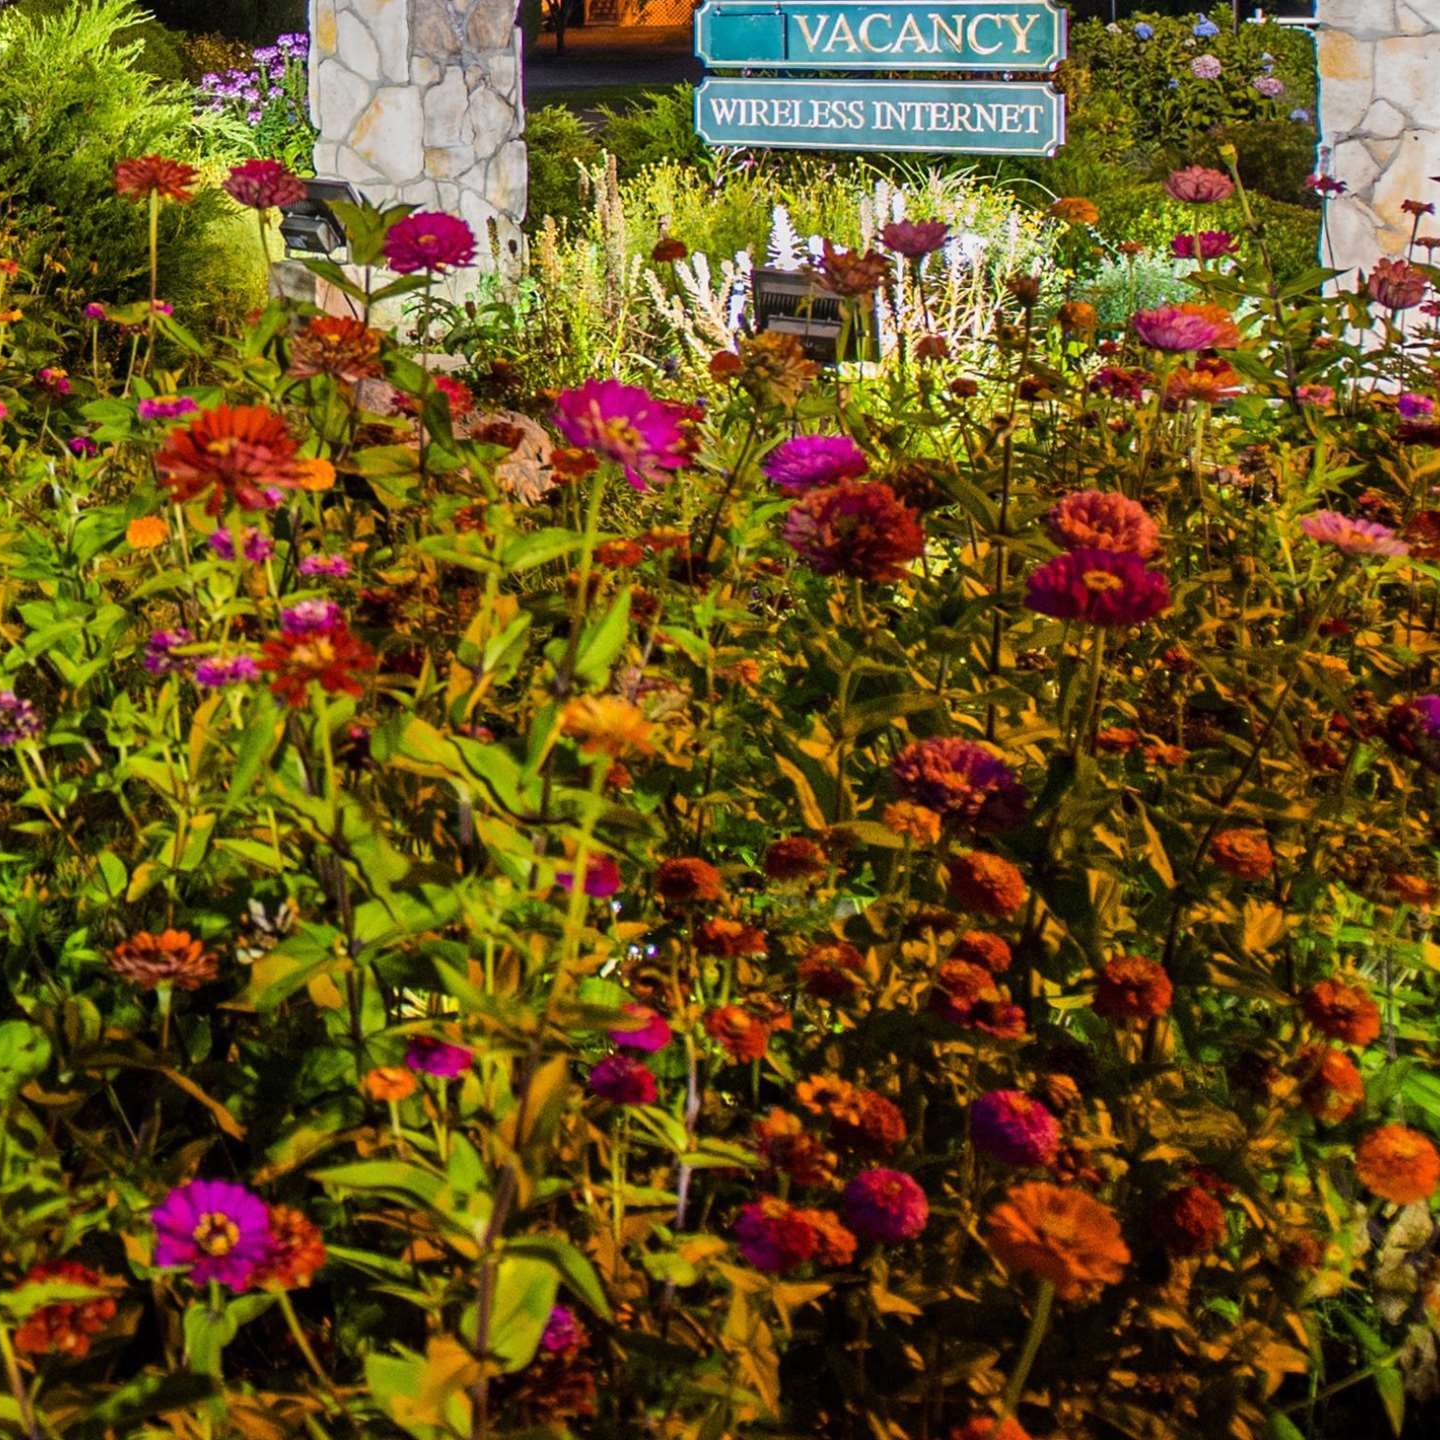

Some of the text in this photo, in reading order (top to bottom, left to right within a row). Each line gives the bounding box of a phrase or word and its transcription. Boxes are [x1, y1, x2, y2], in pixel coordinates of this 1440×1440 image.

[792, 13, 1040, 55] VACANCY
[709, 98, 1044, 134] WIRELESS INTERNET
